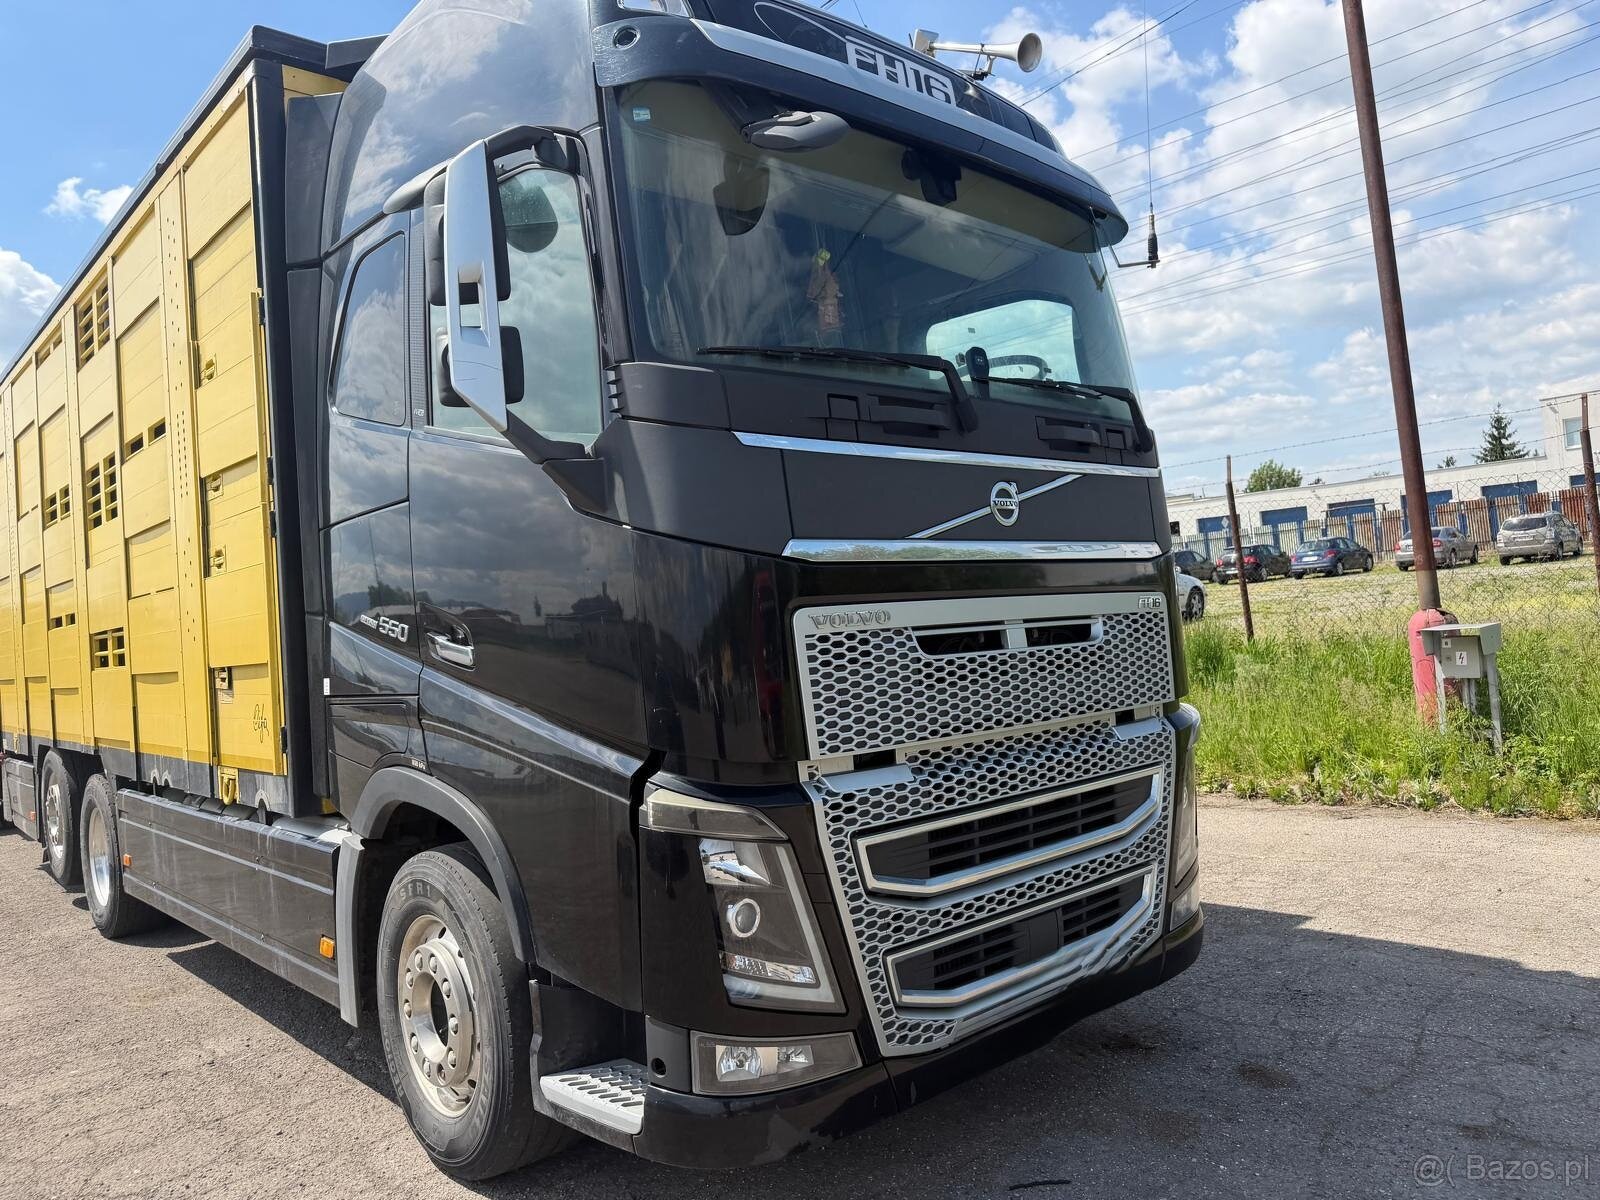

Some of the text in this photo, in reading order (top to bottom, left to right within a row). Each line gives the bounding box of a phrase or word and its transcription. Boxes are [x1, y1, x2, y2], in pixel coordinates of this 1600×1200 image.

[847, 43, 956, 105] FH16
[379, 616, 409, 642] 550
[808, 609, 891, 629] VOLVO
